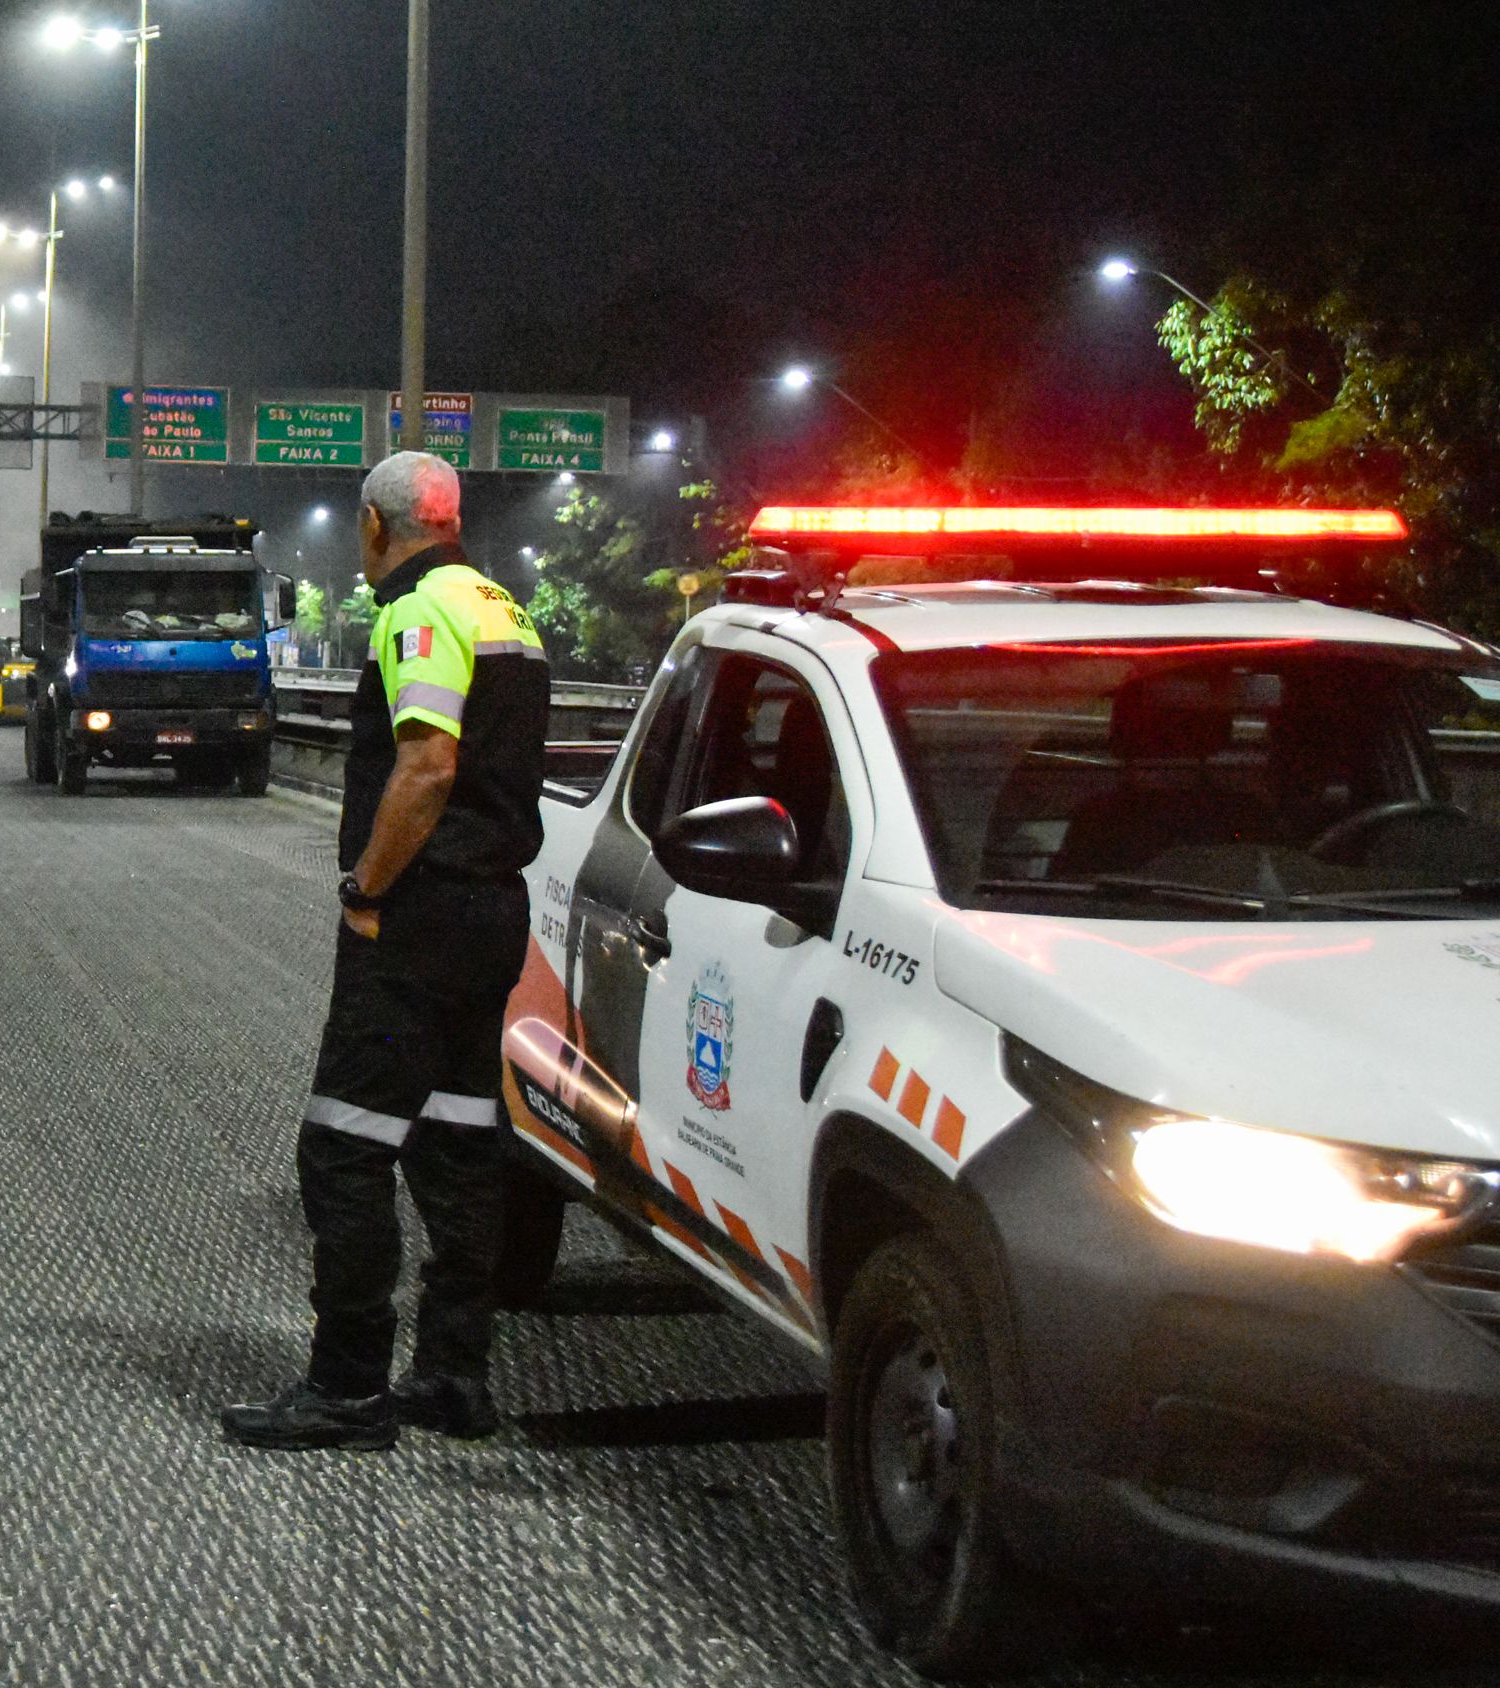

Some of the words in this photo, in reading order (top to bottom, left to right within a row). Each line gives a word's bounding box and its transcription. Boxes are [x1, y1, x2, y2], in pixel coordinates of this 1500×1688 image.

[299, 409, 352, 423] Vicente
[142, 425, 158, 437] ão
[164, 425, 202, 438] Paulo
[287, 424, 333, 438] Santos
[189, 446, 195, 458] 1
[280, 447, 323, 460] FAIXA
[329, 449, 338, 460] 2
[522, 453, 565, 465] FAIXA
[570, 454, 580, 465] 4
[843, 930, 920, 985] L-16175
